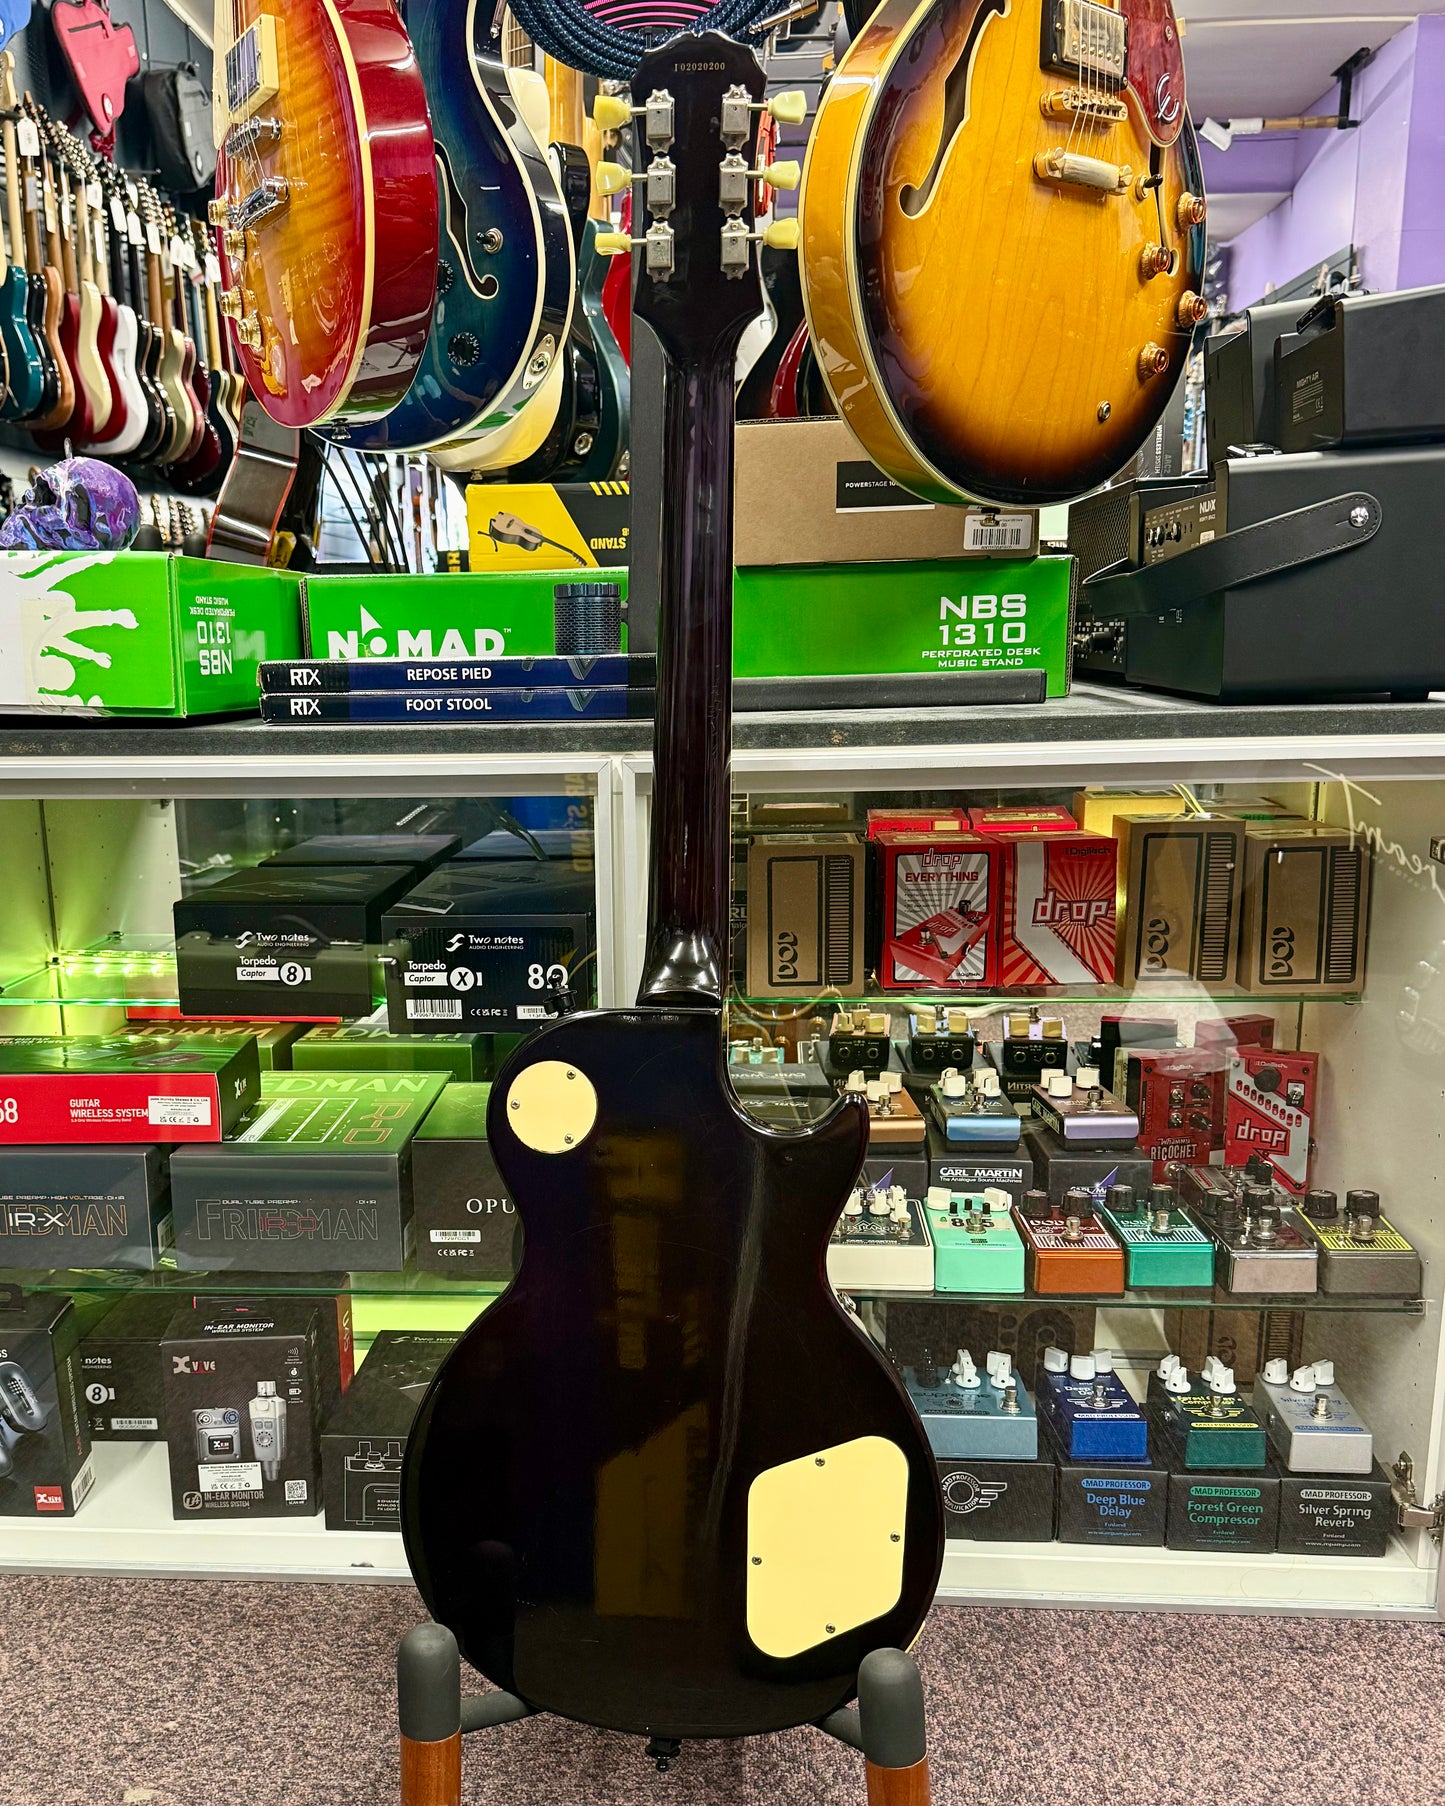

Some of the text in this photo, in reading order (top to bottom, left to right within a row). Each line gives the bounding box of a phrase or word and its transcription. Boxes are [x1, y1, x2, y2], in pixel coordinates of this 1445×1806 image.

[590, 537, 626, 550] STAND
[940, 594, 1027, 620] NBS
[197, 621, 231, 644] 1310
[328, 618, 505, 657] NOMAD
[939, 622, 1026, 645] 1310
[921, 648, 1041, 658] PERFORATED DESK
[199, 650, 233, 675] NBS
[938, 657, 1024, 668] MUSIC STAND
[290, 669, 322, 686] RTX
[407, 668, 492, 681] REPOSE PIED
[290, 699, 322, 716] RTX
[406, 698, 492, 711] FOOT STOOL
[921, 848, 963, 870] drop
[905, 871, 979, 883] EVERYTHING
[1032, 888, 1110, 927] drop
[256, 932, 310, 942] Two notes
[468, 934, 524, 945] Two notes
[240, 955, 277, 968] Torpedo
[407, 960, 447, 973] Torpedo
[240, 965, 298, 983] Captor 8
[408, 971, 469, 987] Captor X
[69, 1099, 100, 1108] GUITAR
[70, 1108, 149, 1118] WIRELESS SYSTEM
[1238, 1118, 1288, 1147] drop
[939, 1166, 969, 1177] CARL
[466, 1198, 516, 1214] OPU
[8, 1212, 66, 1228] IR-X
[196, 1199, 379, 1240] FRIEDMAN
[951, 1218, 995, 1228] 85
[85, 1356, 112, 1365] notes
[92, 1387, 103, 1400] 8
[942, 1474, 980, 1492] MAD PROFESSOR
[1085, 1480, 1148, 1489] MAD PROFESSOR
[204, 1491, 265, 1501] IN-EAR MONITOR
[1194, 1487, 1258, 1497] MAD PROFESSOR
[1304, 1490, 1368, 1500] MAD PROFESSOR
[943, 1496, 980, 1511] AMPLIFICATION
[1086, 1493, 1146, 1506] Deep Blue
[1099, 1505, 1132, 1518] Delay
[1187, 1500, 1264, 1513] Forest Green
[1299, 1504, 1372, 1519] Silver Spring
[1188, 1513, 1261, 1527] Compressor
[1315, 1517, 1355, 1528] Reverb
